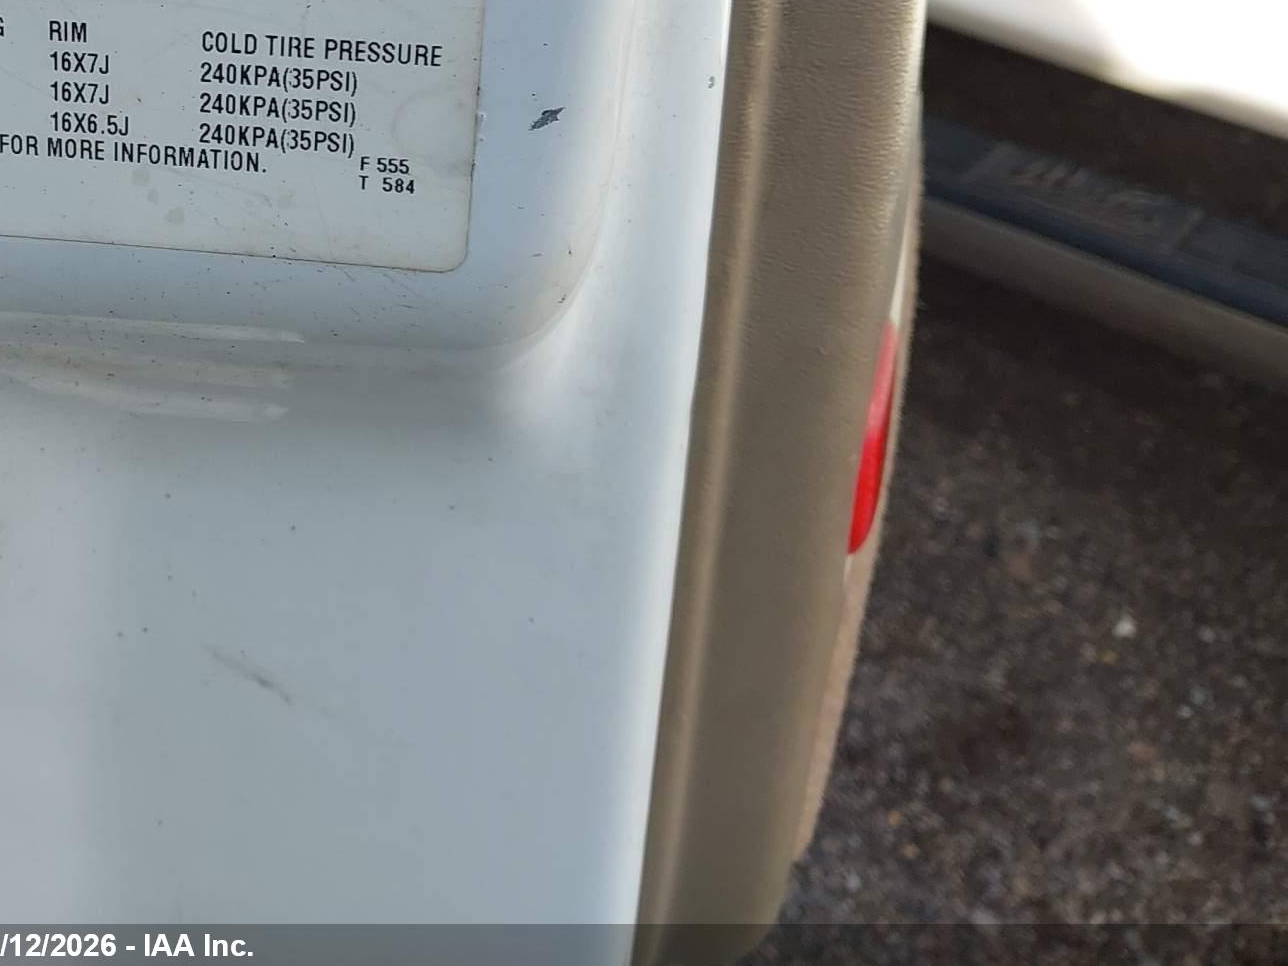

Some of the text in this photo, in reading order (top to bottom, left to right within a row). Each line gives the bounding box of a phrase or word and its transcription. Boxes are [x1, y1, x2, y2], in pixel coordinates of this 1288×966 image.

[48, 20, 88, 43] RIM
[201, 30, 258, 55] COLD
[264, 34, 316, 59] TIRE
[324, 38, 443, 67] PRESSURE
[49, 50, 110, 75] 16X7J
[199, 61, 358, 99] 240KPA(35PSI)
[49, 80, 110, 105] 16X7J
[199, 90, 358, 130] 240KPA(35PSI)
[0, 133, 40, 157] FOR
[47, 136, 105, 161] MORE
[113, 140, 267, 174] INFORMATION.
[49, 110, 129, 137] 16X6.5J
[197, 121, 356, 161] 240KPA(35PSI)
[358, 174, 415, 195] T 584
[359, 155, 411, 176] F 555
